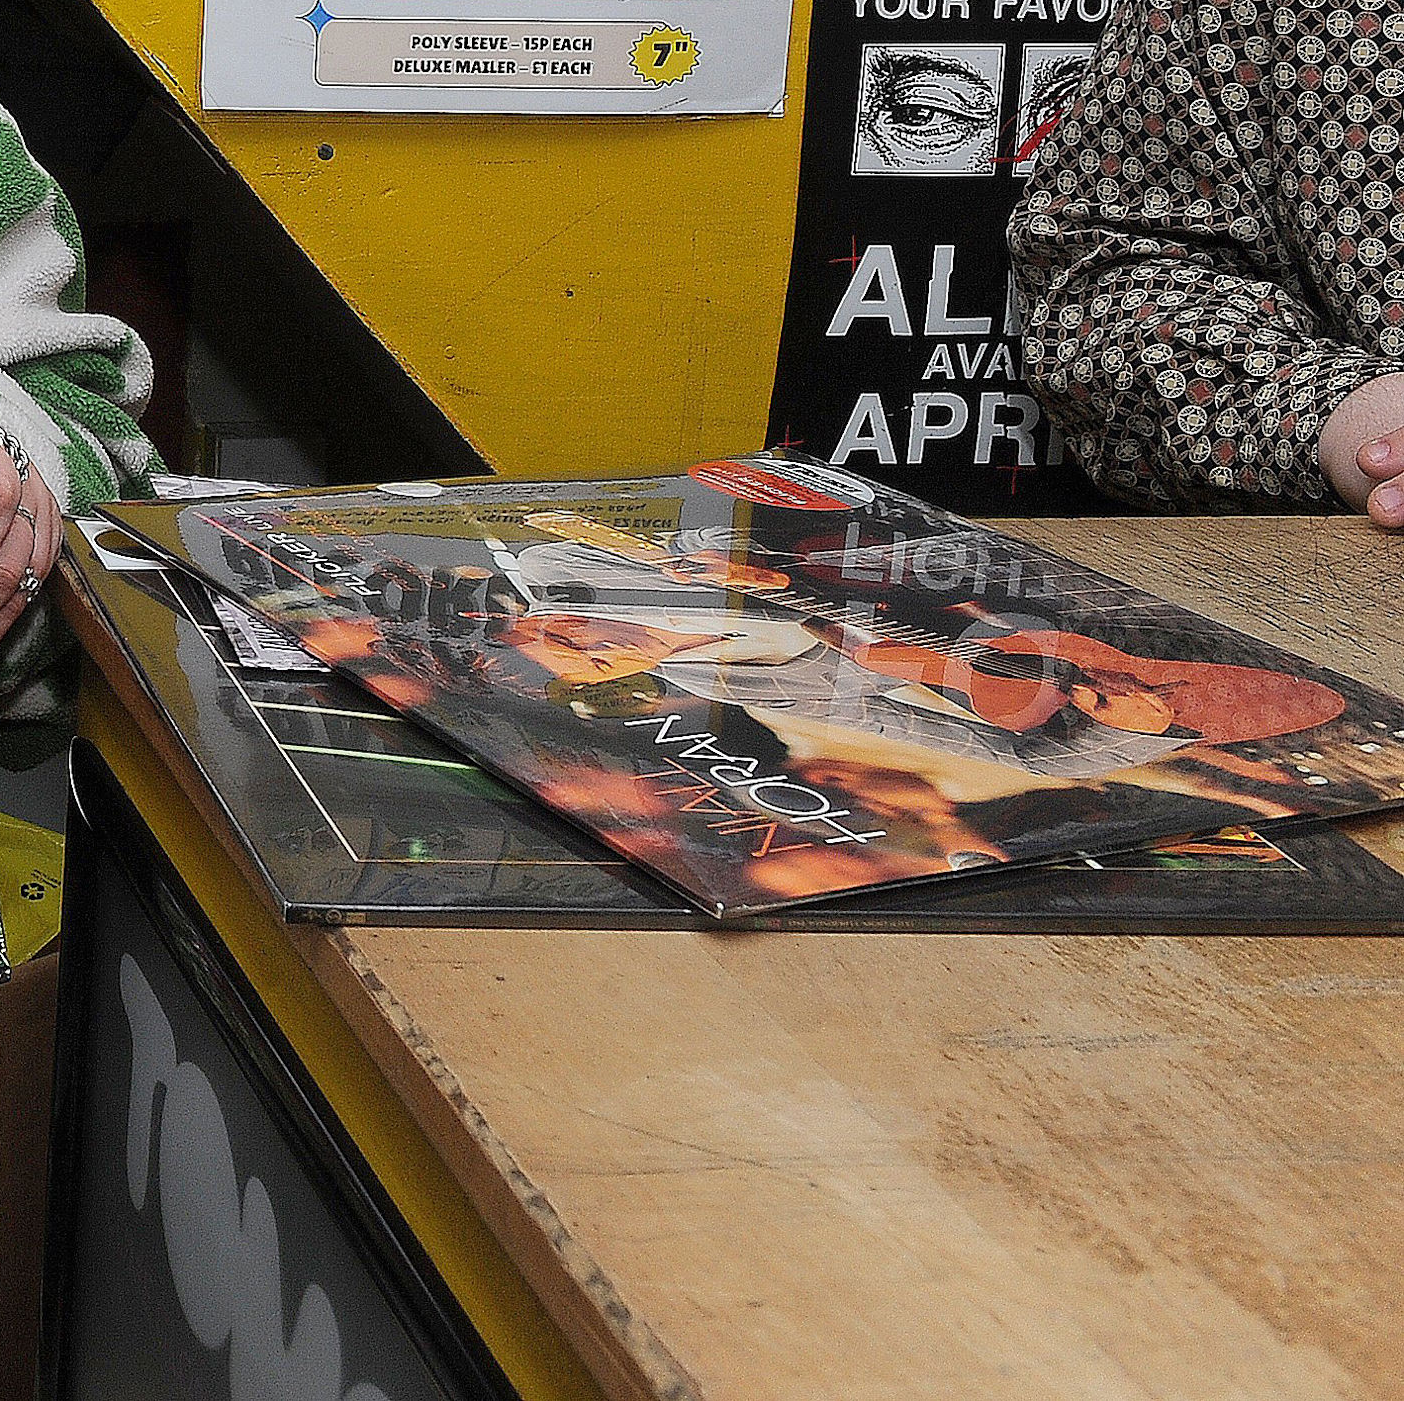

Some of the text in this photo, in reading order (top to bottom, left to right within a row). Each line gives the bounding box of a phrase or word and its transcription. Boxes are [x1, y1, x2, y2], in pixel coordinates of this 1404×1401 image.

[411, 35, 594, 52] POLY SLEEVE EACH
[652, 40, 688, 67] 7"
[393, 59, 592, 76] DELUXE MAILER EACH
